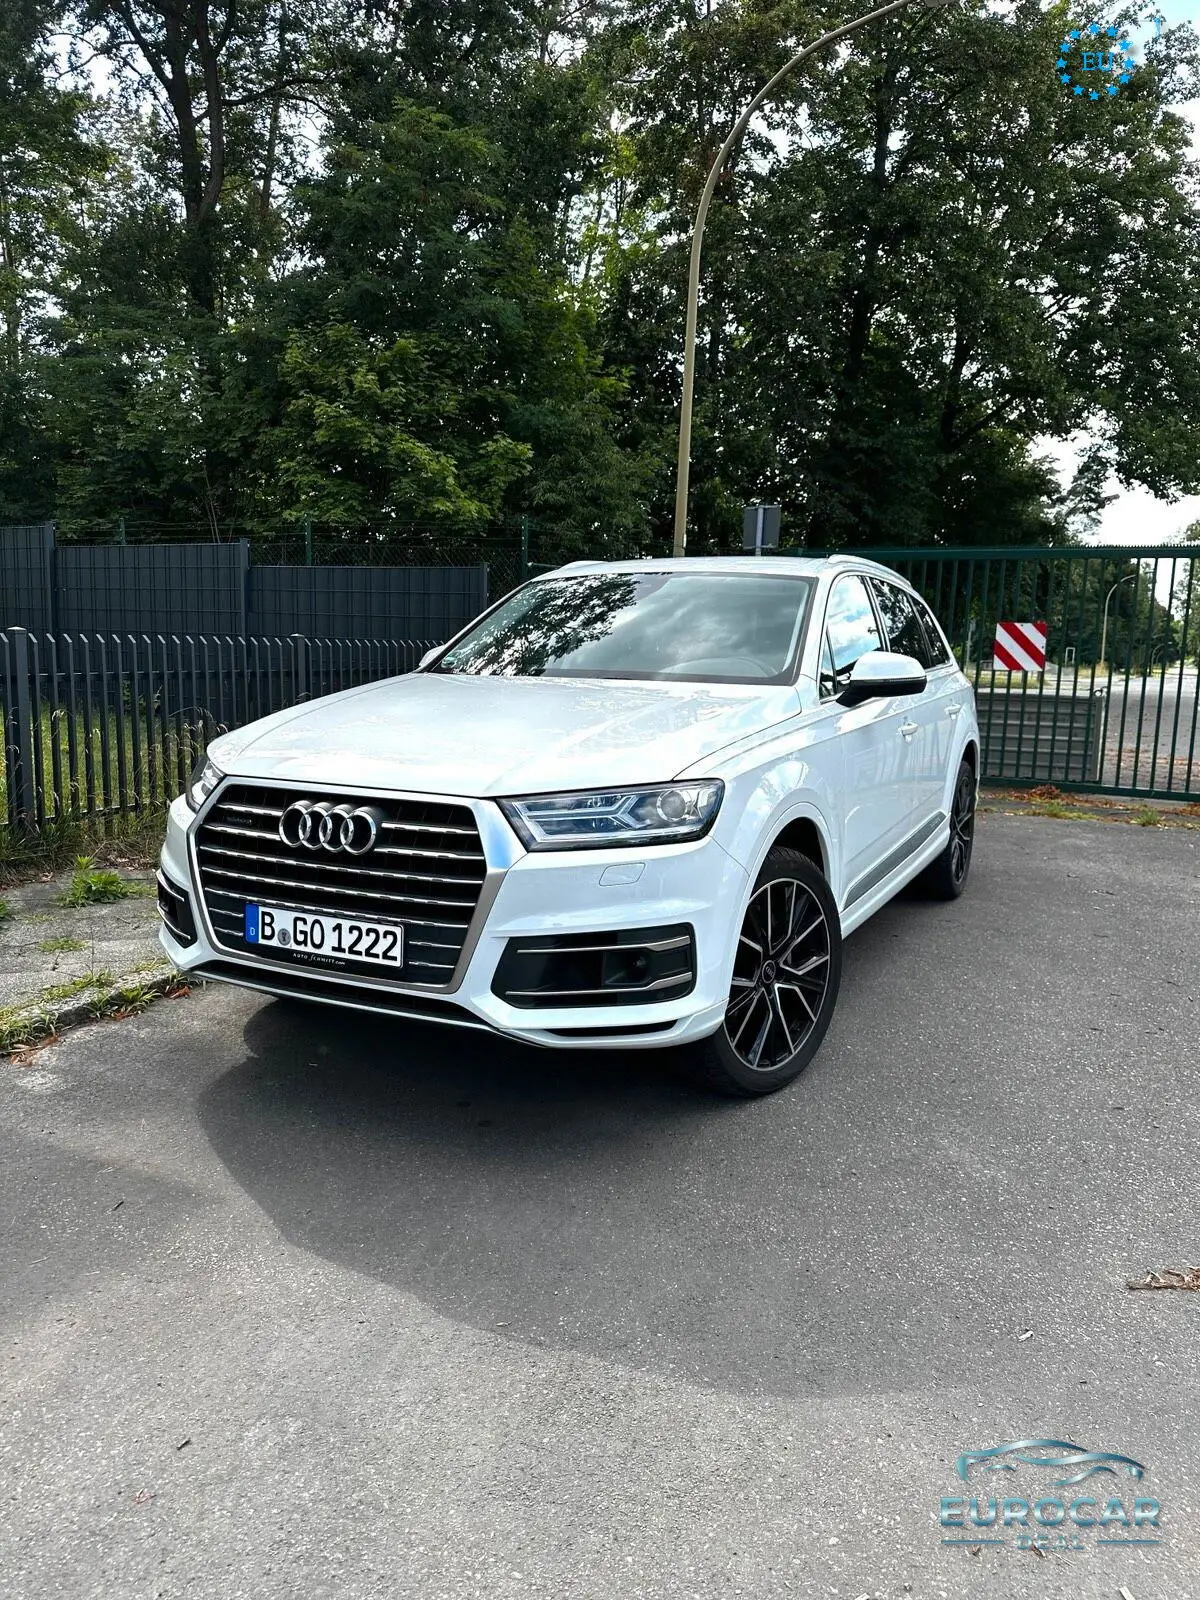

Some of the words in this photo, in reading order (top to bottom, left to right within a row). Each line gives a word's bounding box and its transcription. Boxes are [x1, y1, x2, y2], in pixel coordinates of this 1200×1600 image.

[261, 911, 276, 941] B
[293, 916, 325, 949] GO
[331, 923, 398, 961] 1222
